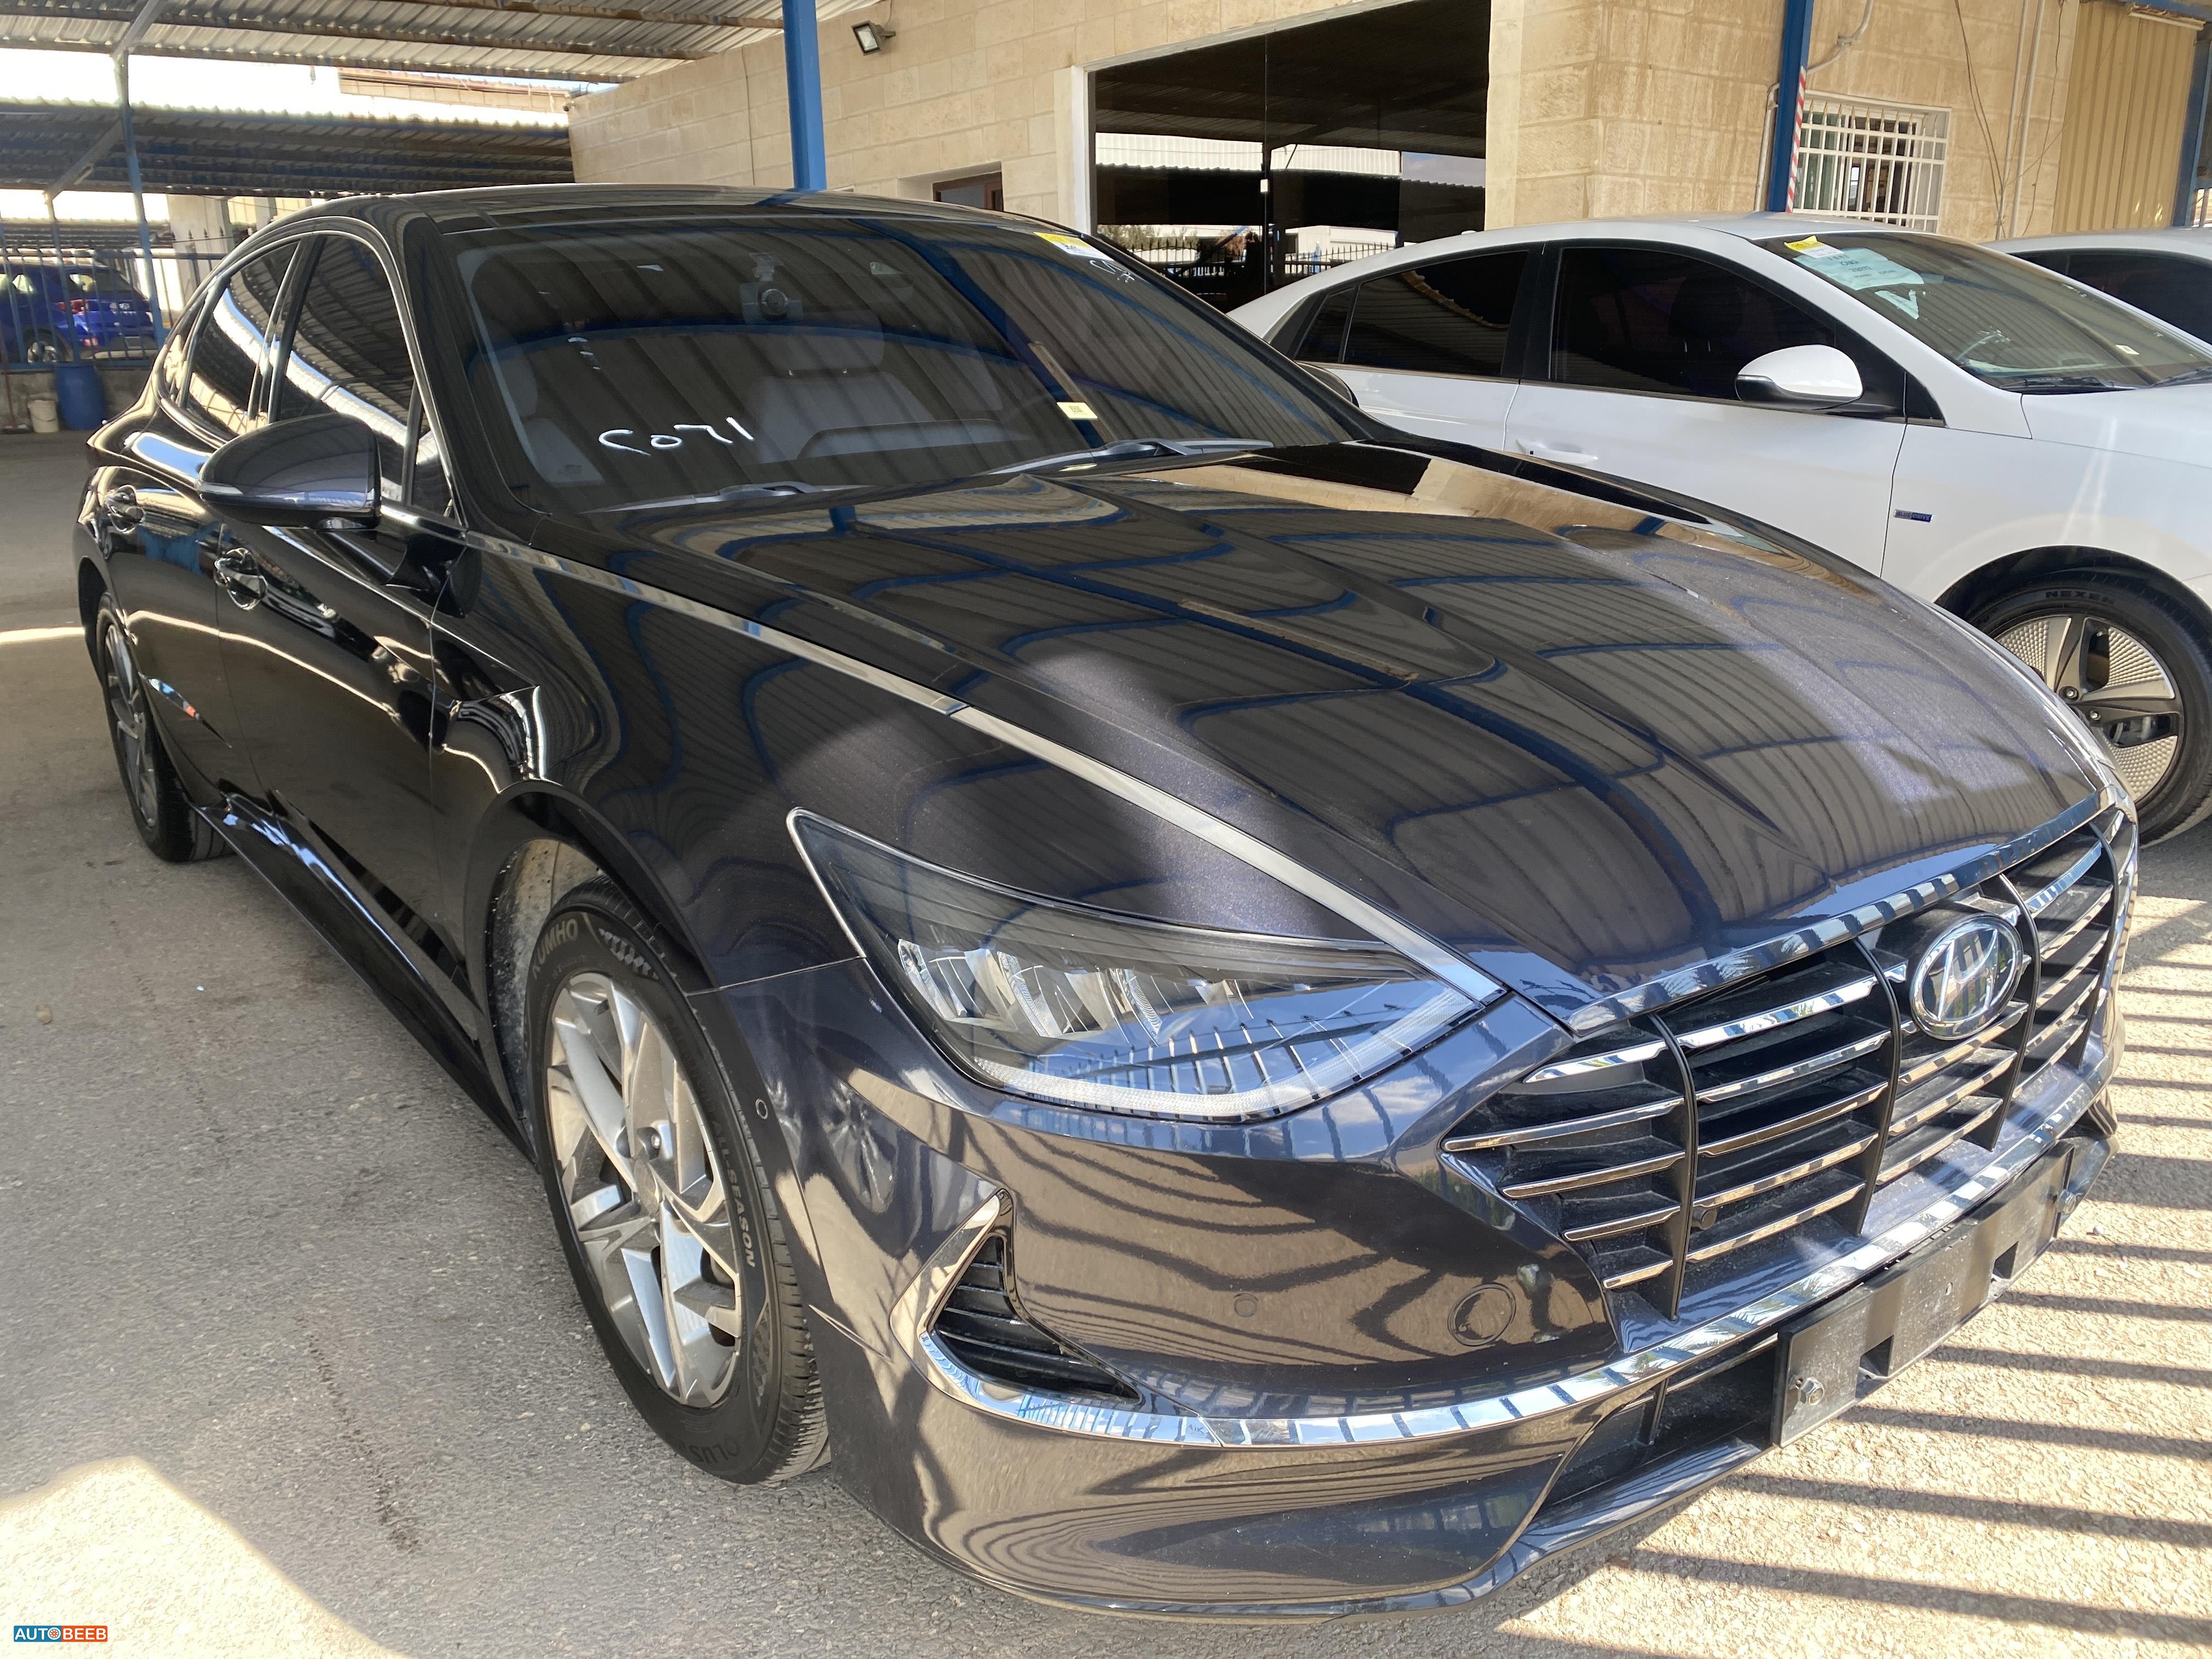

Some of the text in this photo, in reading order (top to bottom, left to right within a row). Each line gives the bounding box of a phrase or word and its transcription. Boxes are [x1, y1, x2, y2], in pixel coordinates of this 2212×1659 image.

[1912, 513, 1931, 521] DRIVE
[2045, 590, 2115, 605] NEXEN
[532, 918, 578, 980] KUMHO
[689, 1437, 742, 1464] OLUS
